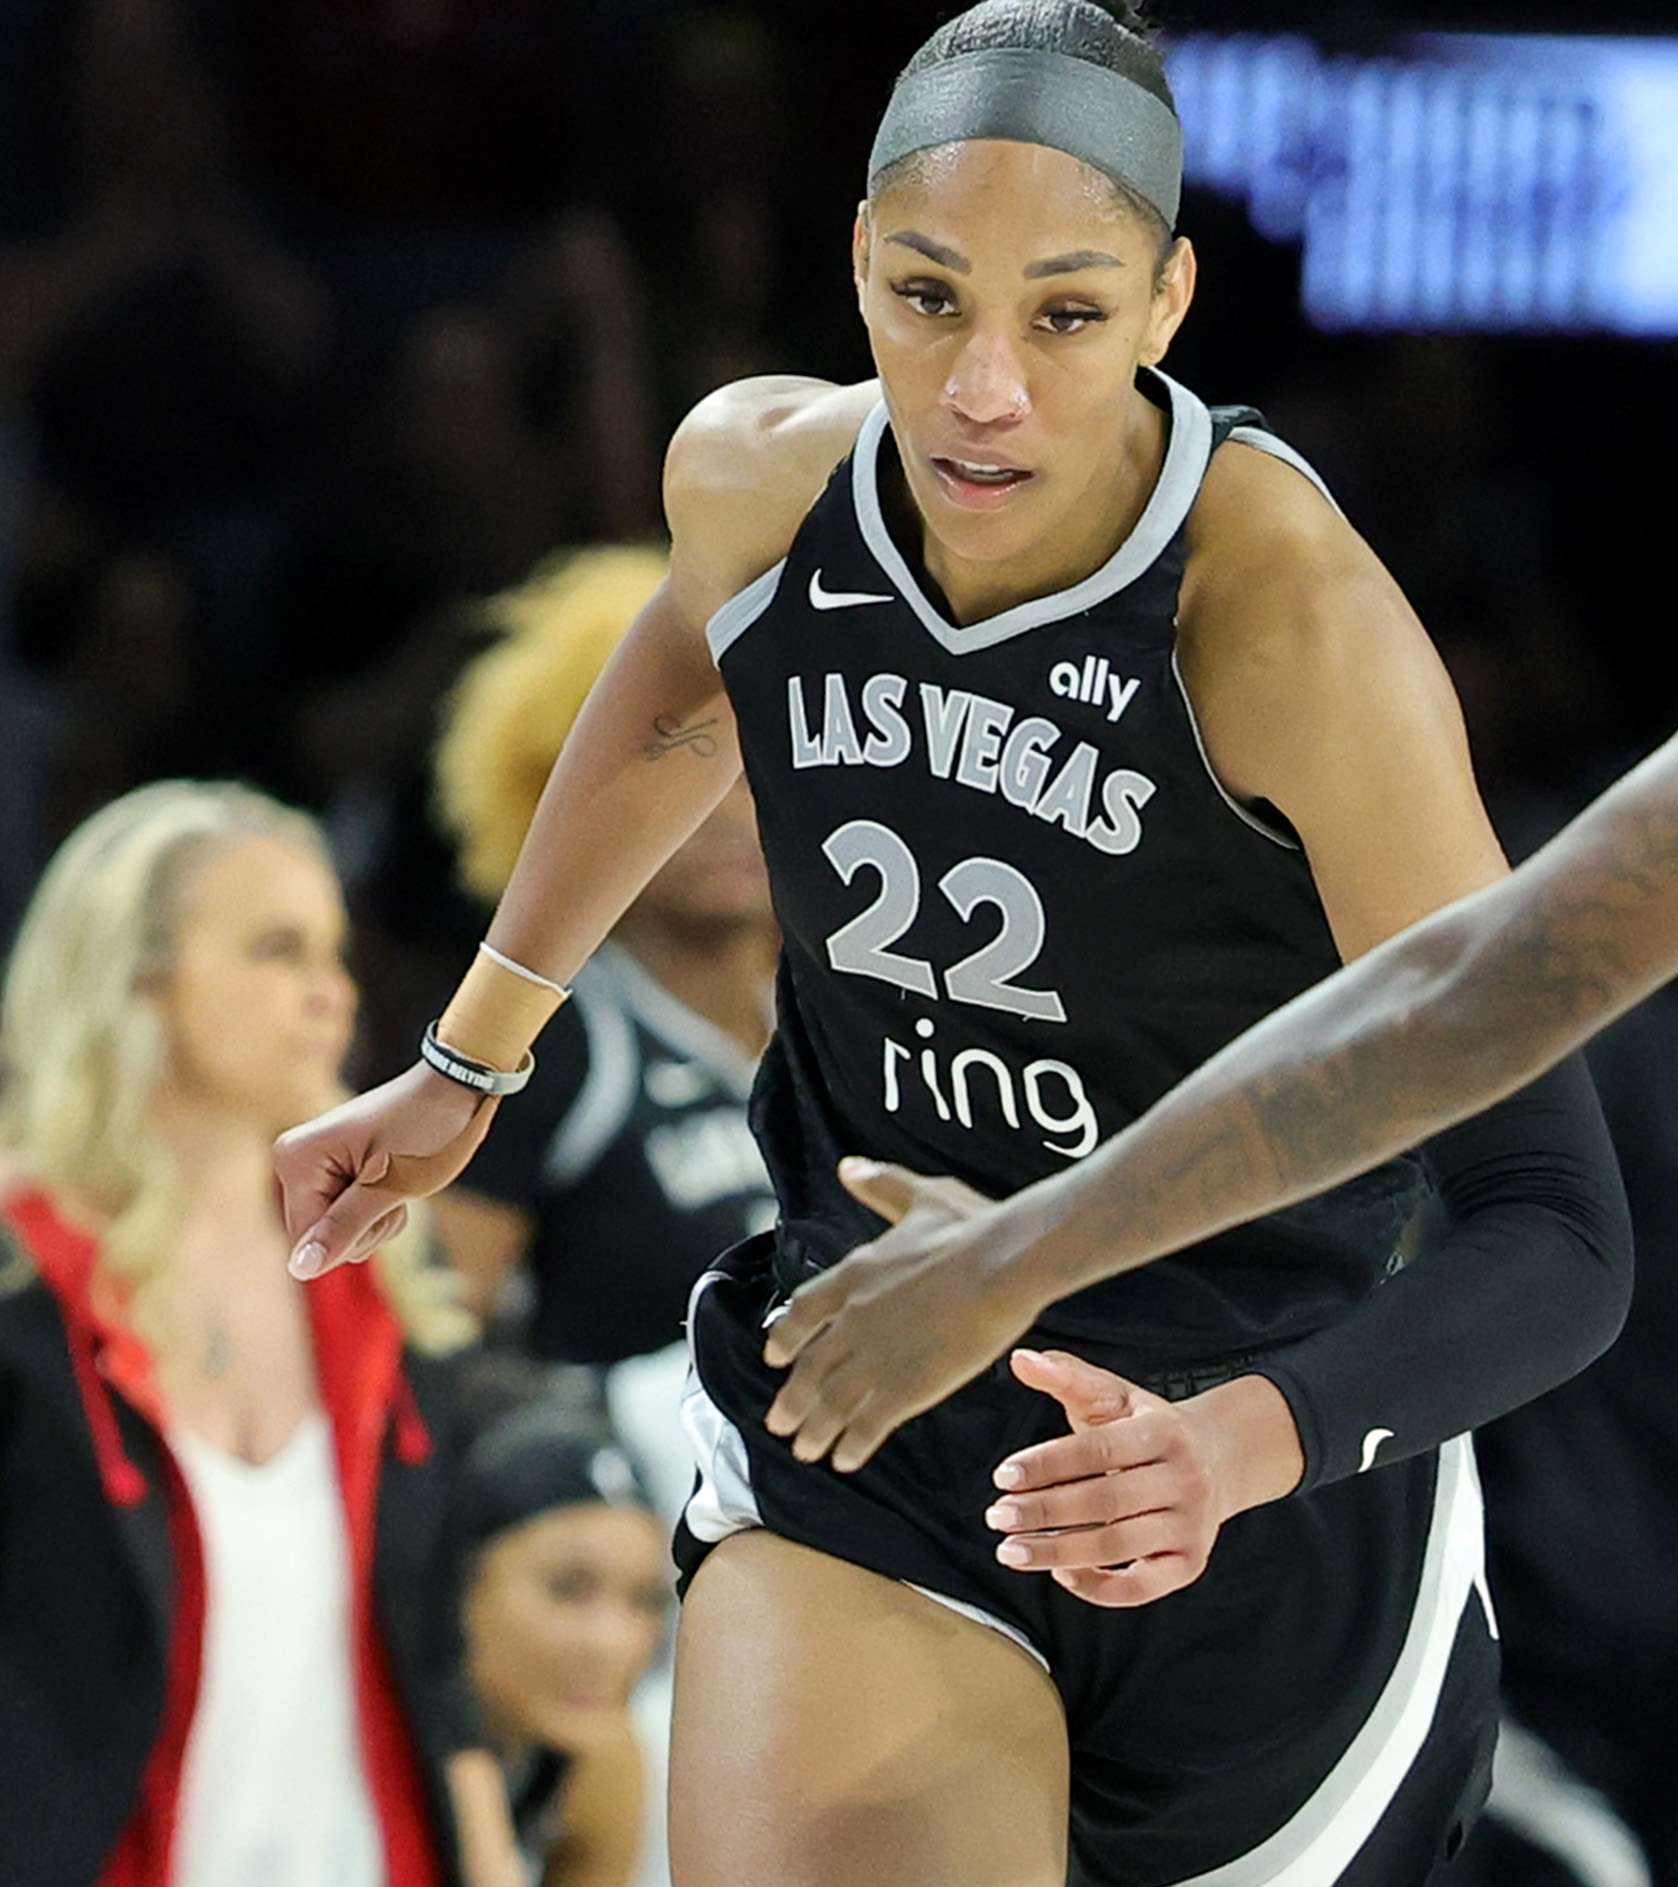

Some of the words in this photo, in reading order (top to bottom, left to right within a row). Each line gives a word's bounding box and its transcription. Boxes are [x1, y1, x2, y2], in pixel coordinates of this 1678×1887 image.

[787, 673, 911, 769] LAS
[919, 682, 1157, 856] VEGAS
[1048, 655, 1140, 722] ally
[821, 819, 1067, 1023] 22
[883, 1017, 1099, 1160] ring
